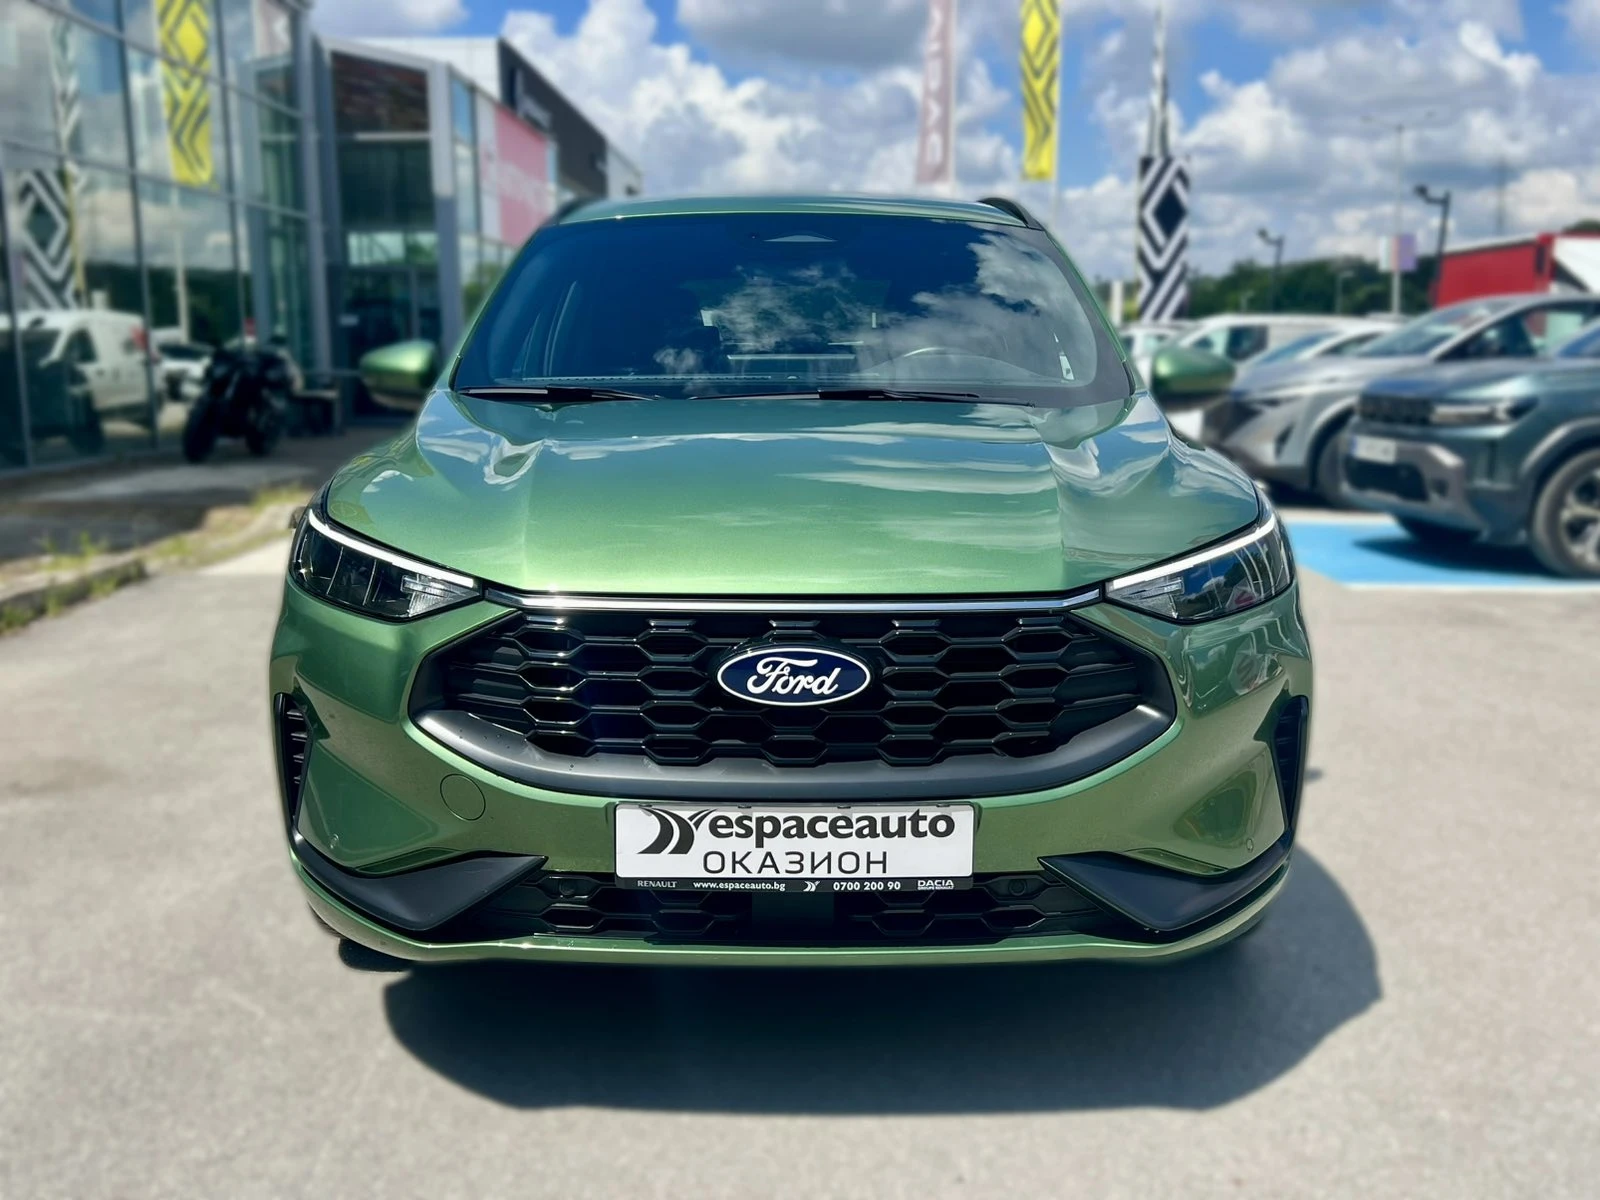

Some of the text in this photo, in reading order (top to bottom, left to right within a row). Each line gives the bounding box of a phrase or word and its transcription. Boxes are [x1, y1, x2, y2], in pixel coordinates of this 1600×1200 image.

[746, 656, 842, 695] Ford
[708, 808, 955, 848] espaceauto
[703, 850, 888, 875] ОКАЗИОН
[637, 880, 677, 888] RENAULT
[693, 880, 786, 892] www.espaceauto.bg
[833, 881, 901, 891] 0700 200 90
[917, 879, 954, 887] DACIA
